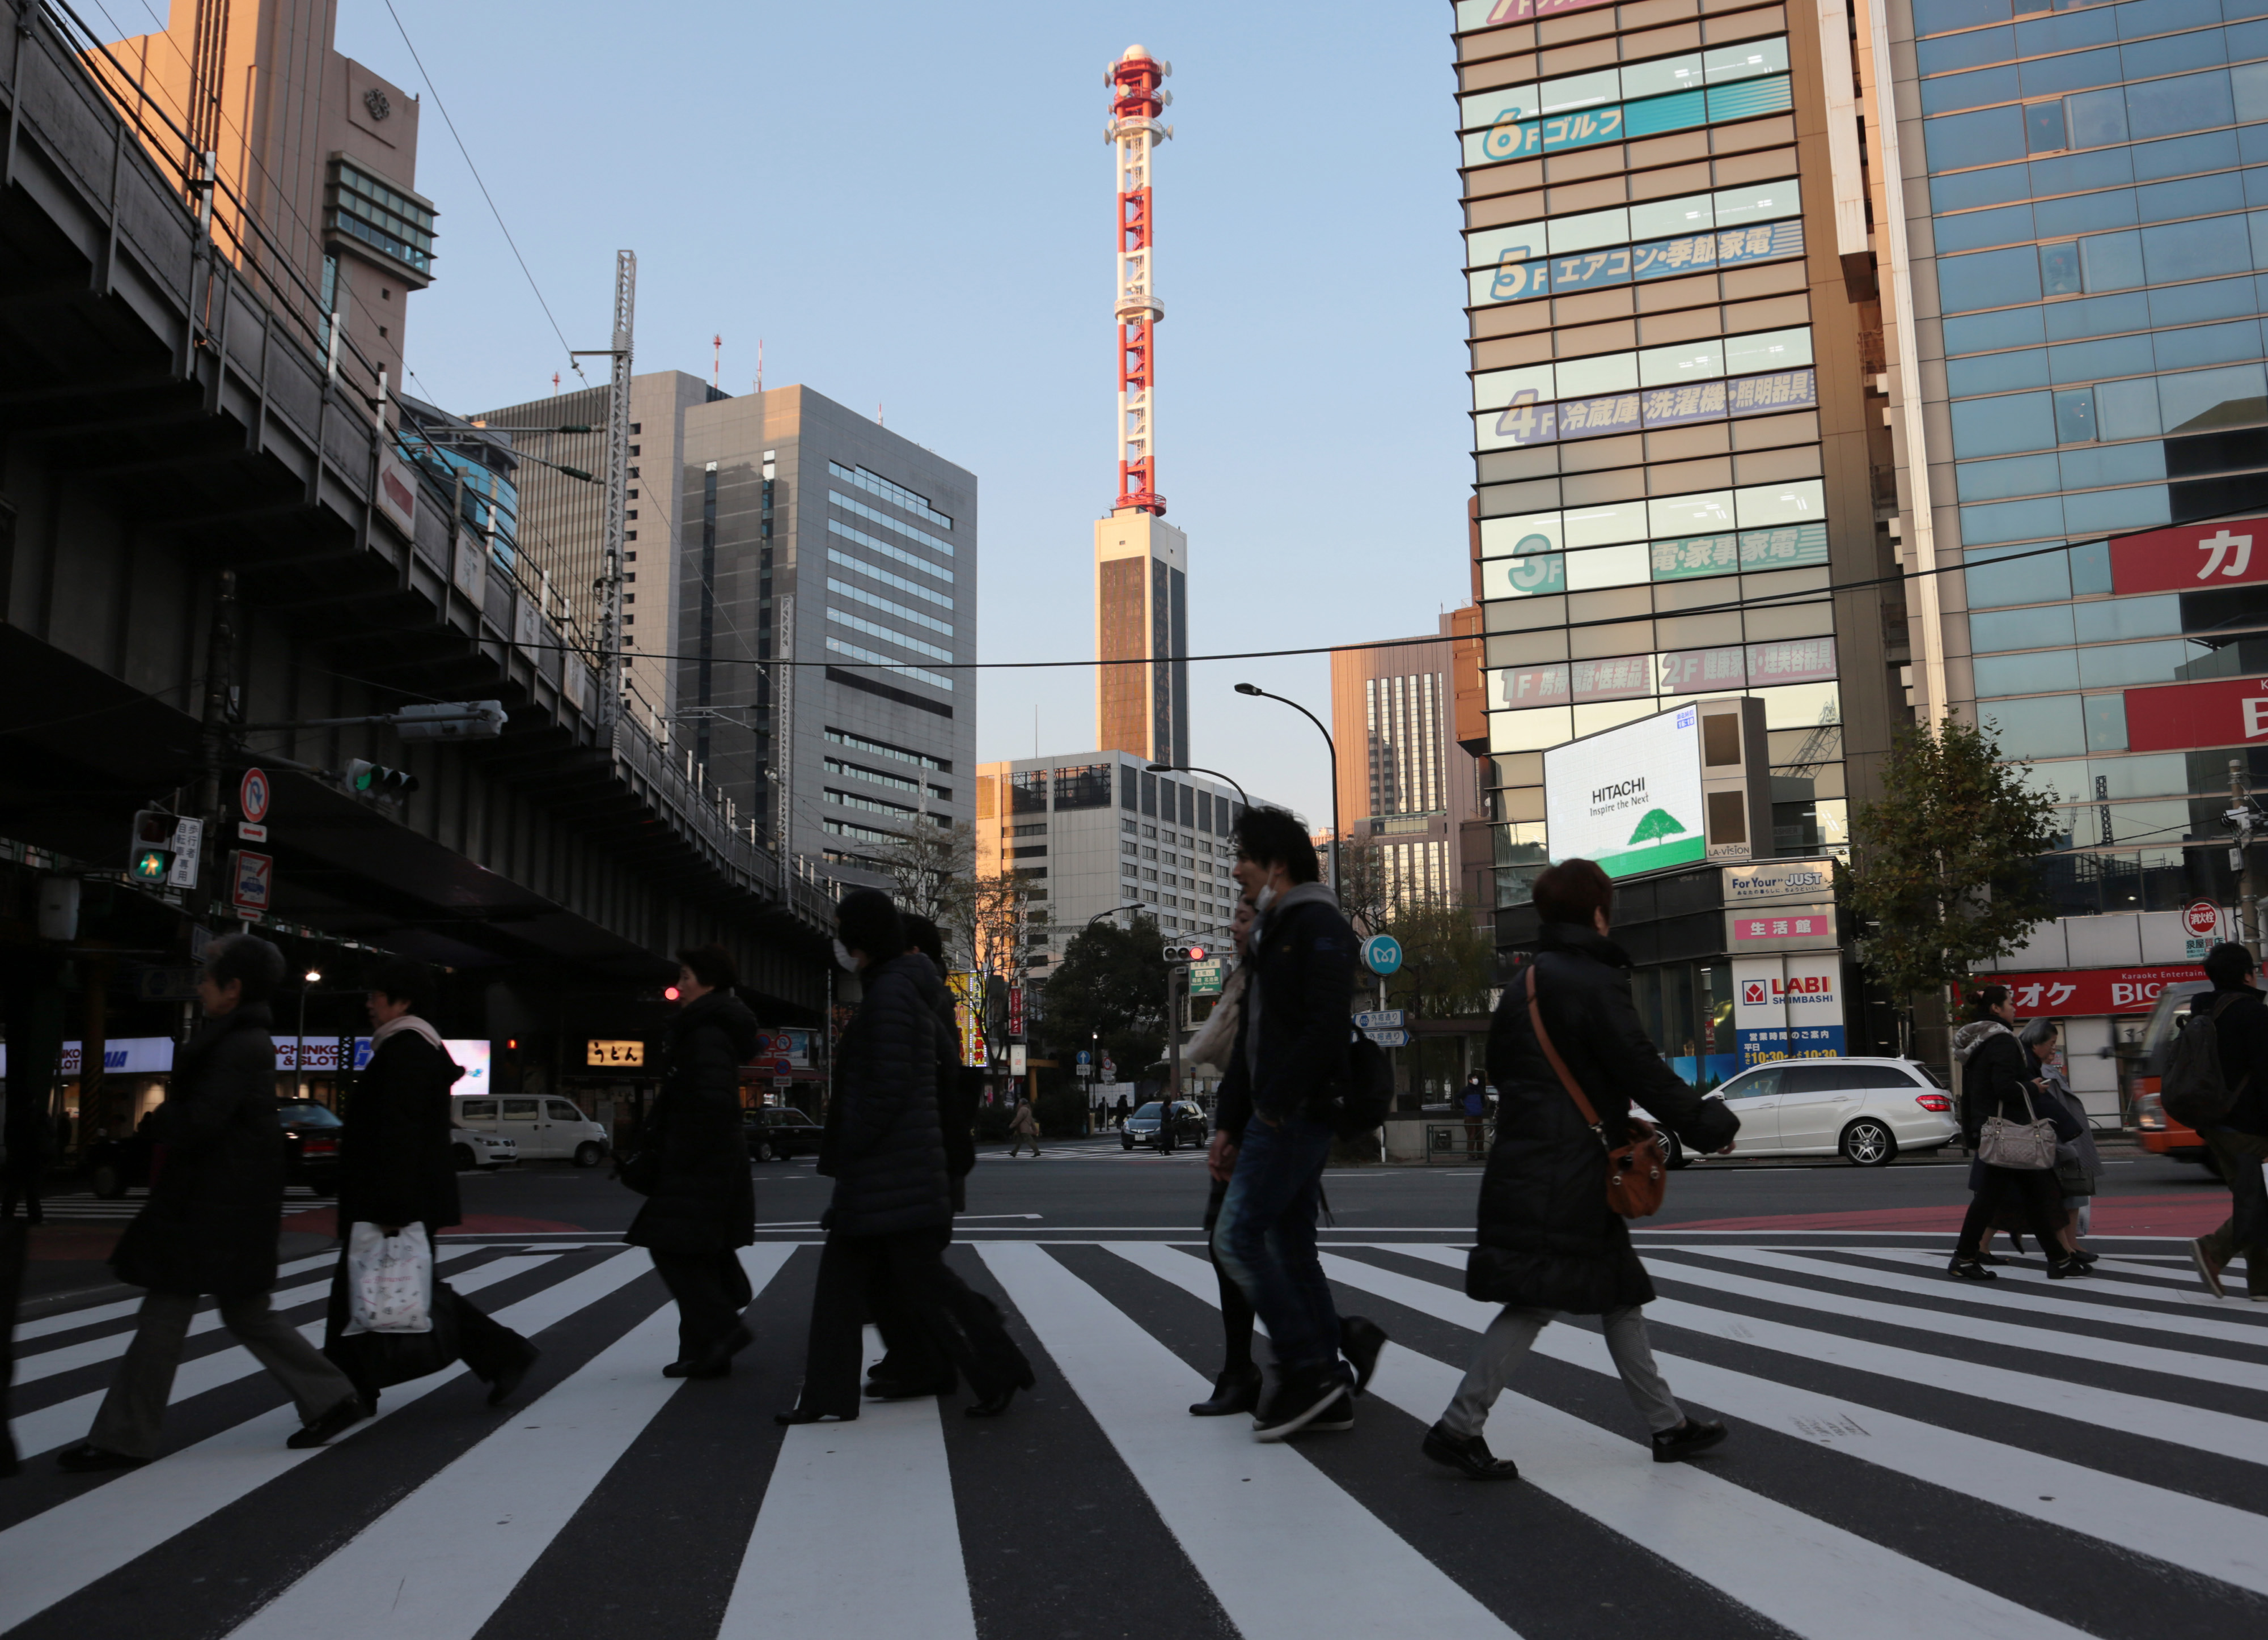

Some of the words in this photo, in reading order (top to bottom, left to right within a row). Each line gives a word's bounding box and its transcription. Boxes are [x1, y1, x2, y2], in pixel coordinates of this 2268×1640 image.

[1486, 111, 1539, 156] 6F
[1543, 109, 1622, 144] ゴルフ
[1493, 249, 1547, 297] 5F
[1556, 228, 1772, 283] エアコン・季節家電
[1500, 393, 1555, 438] 4F
[1560, 371, 1809, 431] 冷蔵庫・洗濯機・照明器具
[1512, 537, 1562, 588] 3F
[2196, 529, 2253, 580] カ
[1664, 654, 1699, 684] 2F
[1703, 640, 1831, 681] 健康家電・理美容器具
[1504, 671, 1532, 700] 1F
[1538, 659, 1643, 696] 携帯電話・医薬品
[1592, 777, 1645, 804] HITACHI
[1589, 804, 1615, 817] Inspire
[1617, 800, 1629, 810] the
[1631, 794, 1649, 806] Next
[175, 823, 187, 856] 自転車
[185, 824, 199, 858] 歩行者
[177, 859, 190, 882] 専用
[1732, 878, 1750, 889] For
[1784, 872, 1822, 887] JUST
[1750, 919, 1812, 936] 生活館
[2190, 911, 2215, 925] 消火栓
[1772, 976, 1831, 995] LABI
[2121, 972, 2157, 980] Karaoke
[2160, 969, 2206, 978] Entertain
[1772, 995, 1833, 1005] SHIMBASHI
[2004, 982, 2077, 1007] オケ
[1371, 1012, 1398, 1022] 外堀通り
[1369, 1032, 1400, 1041] 外堀通り
[1744, 1043, 1761, 1052] 平日
[1749, 1030, 1830, 1042] 営業時間のご案内
[301, 1056, 338, 1066] SLOT
[594, 1042, 637, 1063] うどん
